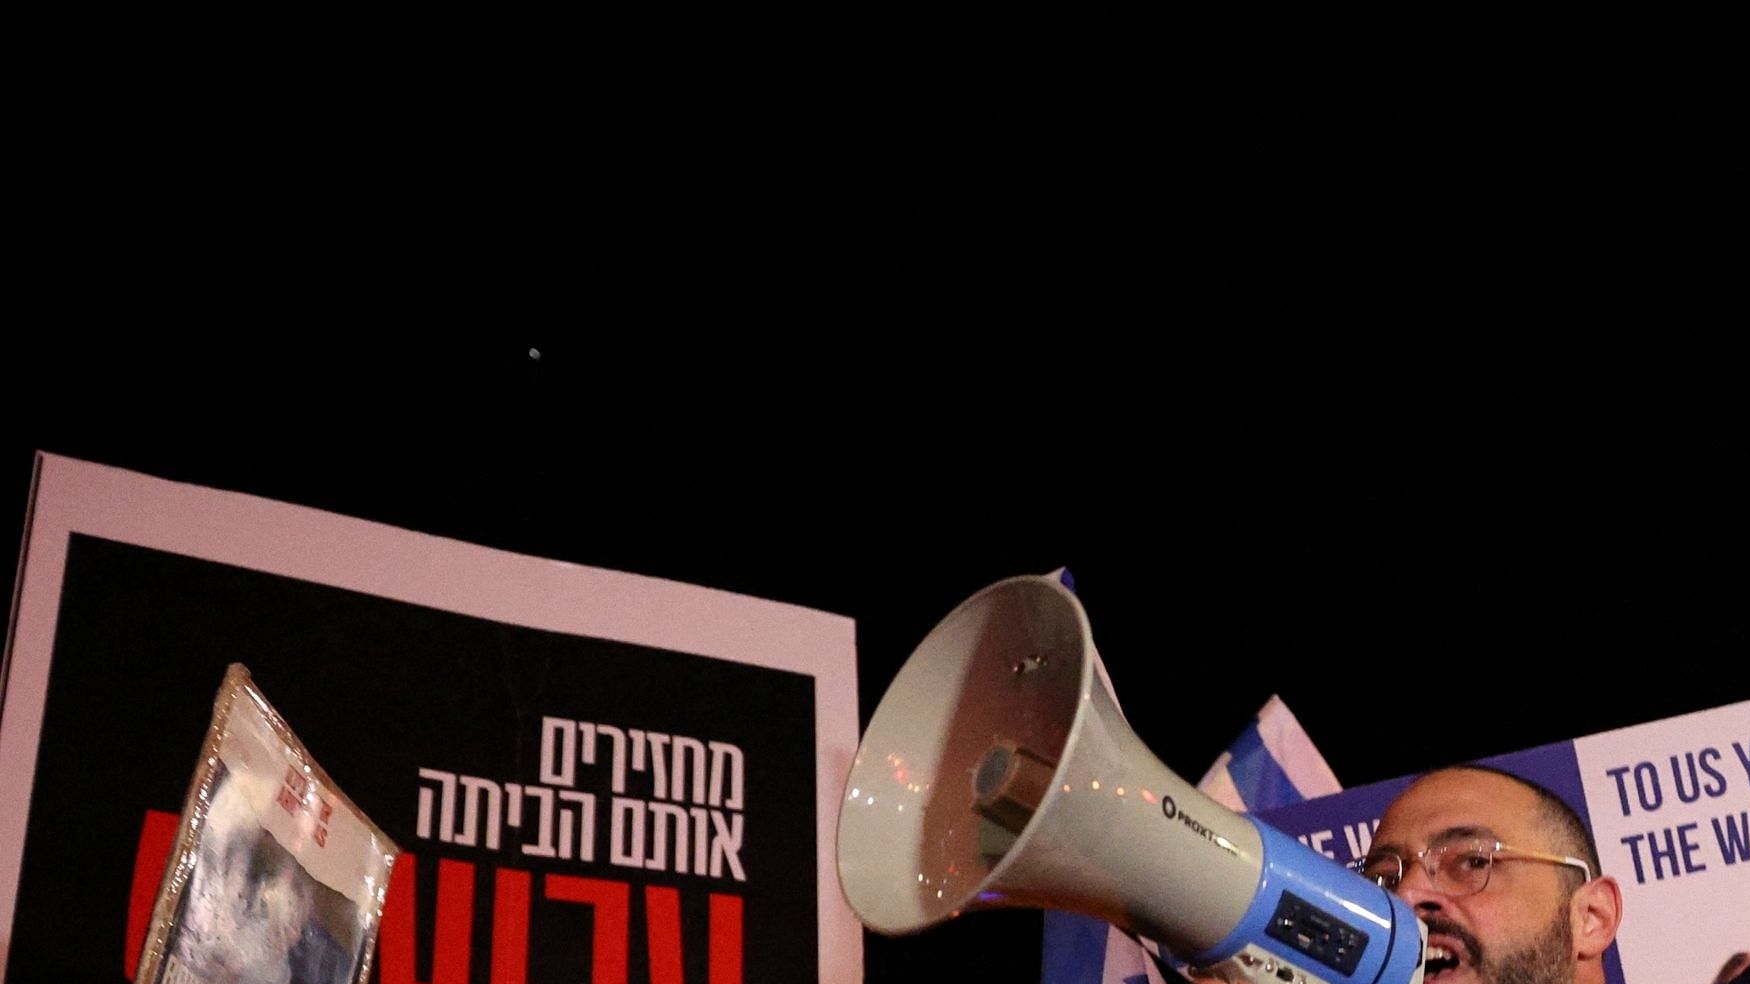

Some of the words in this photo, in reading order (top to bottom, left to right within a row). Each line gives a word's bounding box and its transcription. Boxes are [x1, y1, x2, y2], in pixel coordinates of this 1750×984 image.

[540, 716, 745, 811] מחזירים
[1606, 761, 1663, 817] TO
[1670, 747, 1728, 804] US
[416, 767, 596, 863] הביתה
[610, 796, 747, 882] אותם
[1178, 809, 1237, 856] PROXT
[1620, 822, 1707, 885] THE
